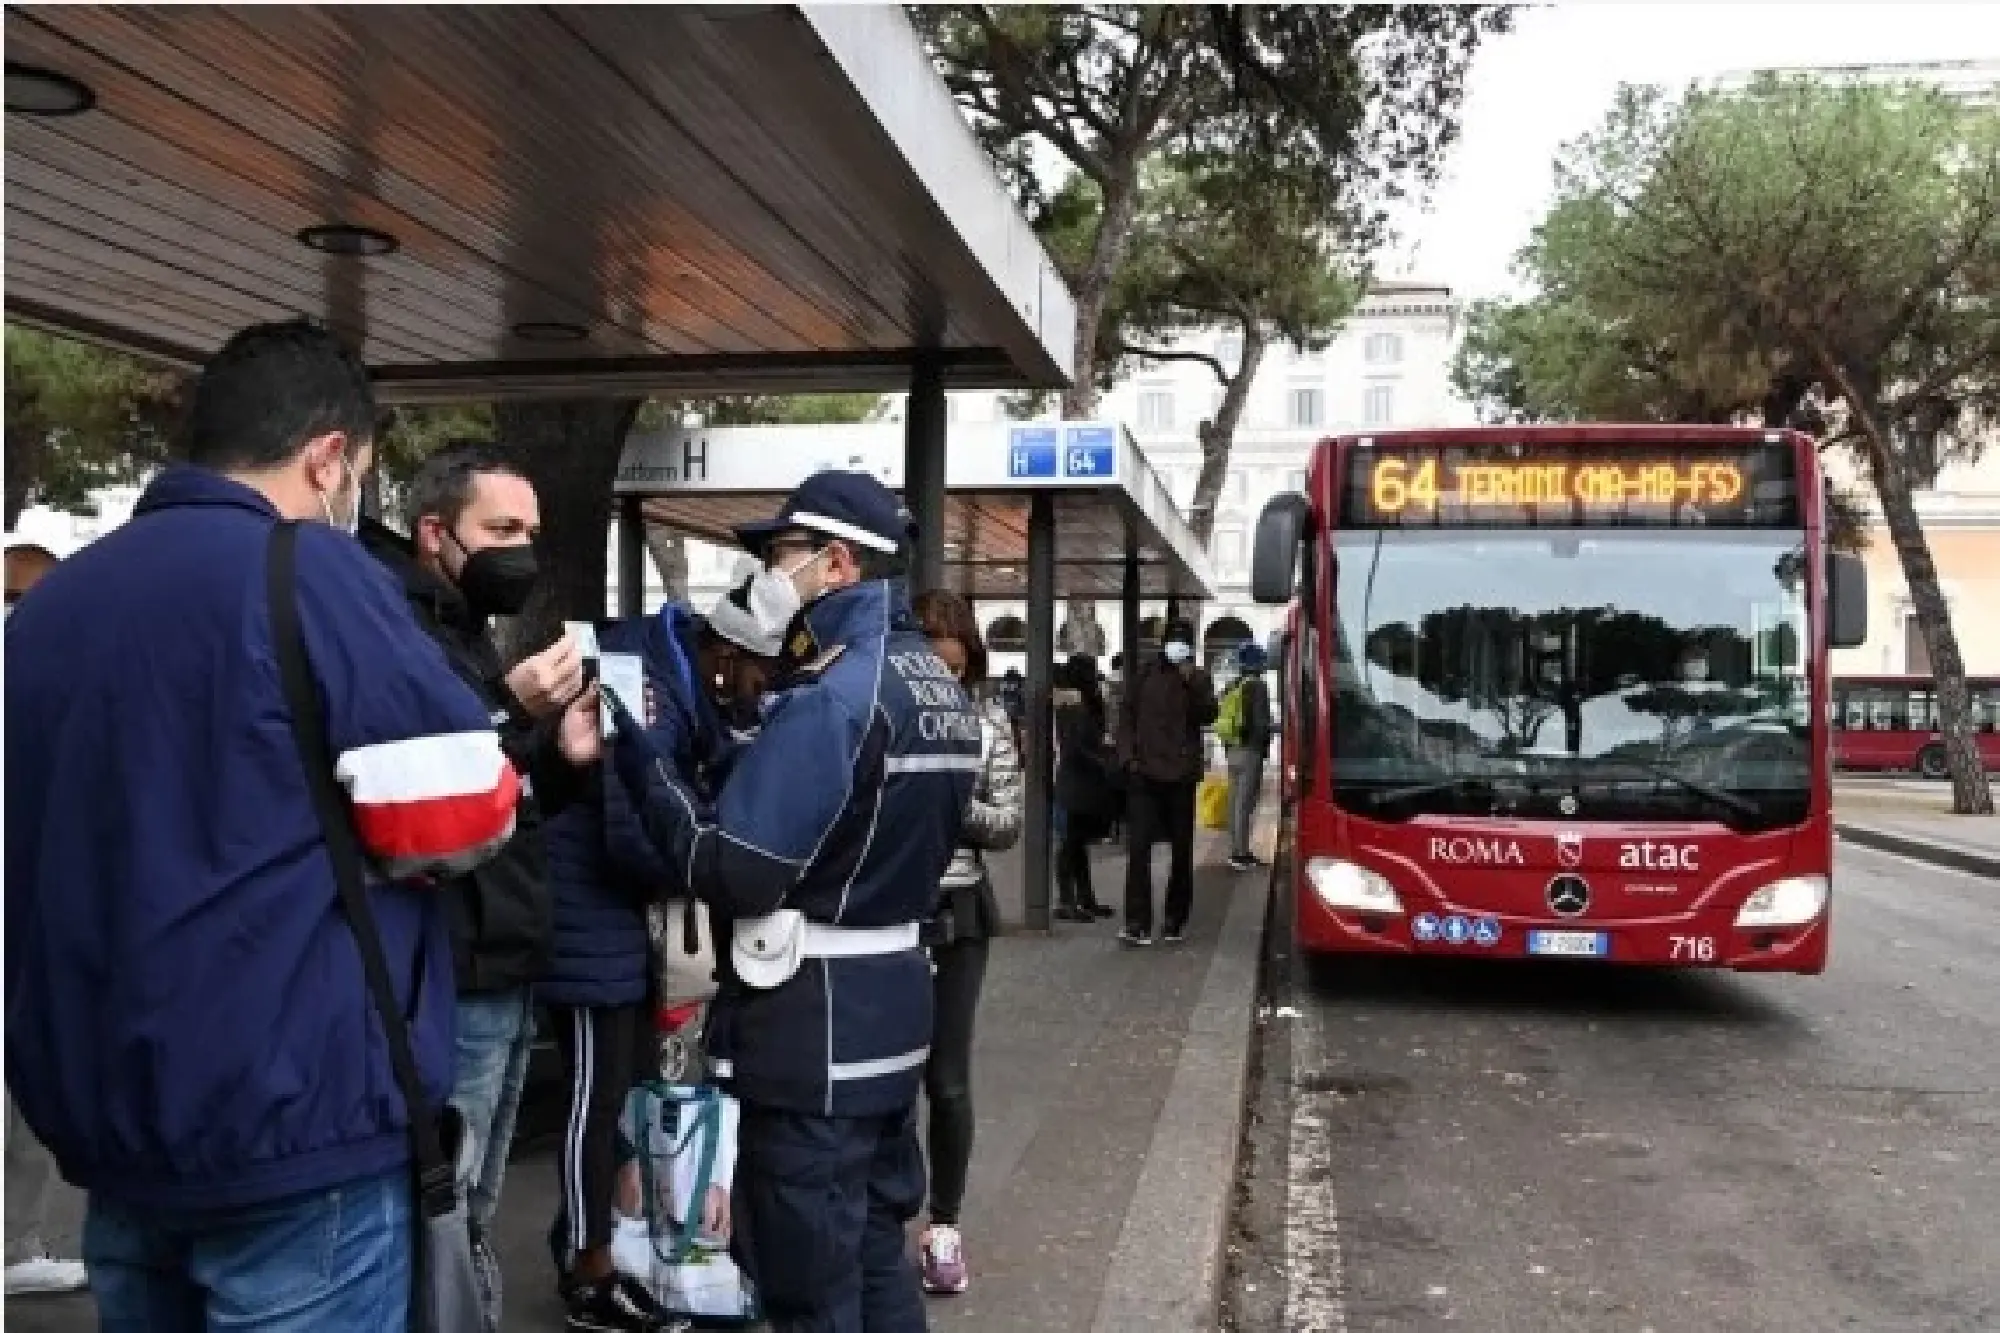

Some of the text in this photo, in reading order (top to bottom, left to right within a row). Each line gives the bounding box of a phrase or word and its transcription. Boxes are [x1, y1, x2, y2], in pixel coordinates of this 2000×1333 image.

[683, 438, 707, 481] H
[1374, 459, 1438, 511] 64
[1456, 465, 1567, 503] TERMINI
[1430, 837, 1524, 864] ROMA
[1619, 840, 1699, 870] atac
